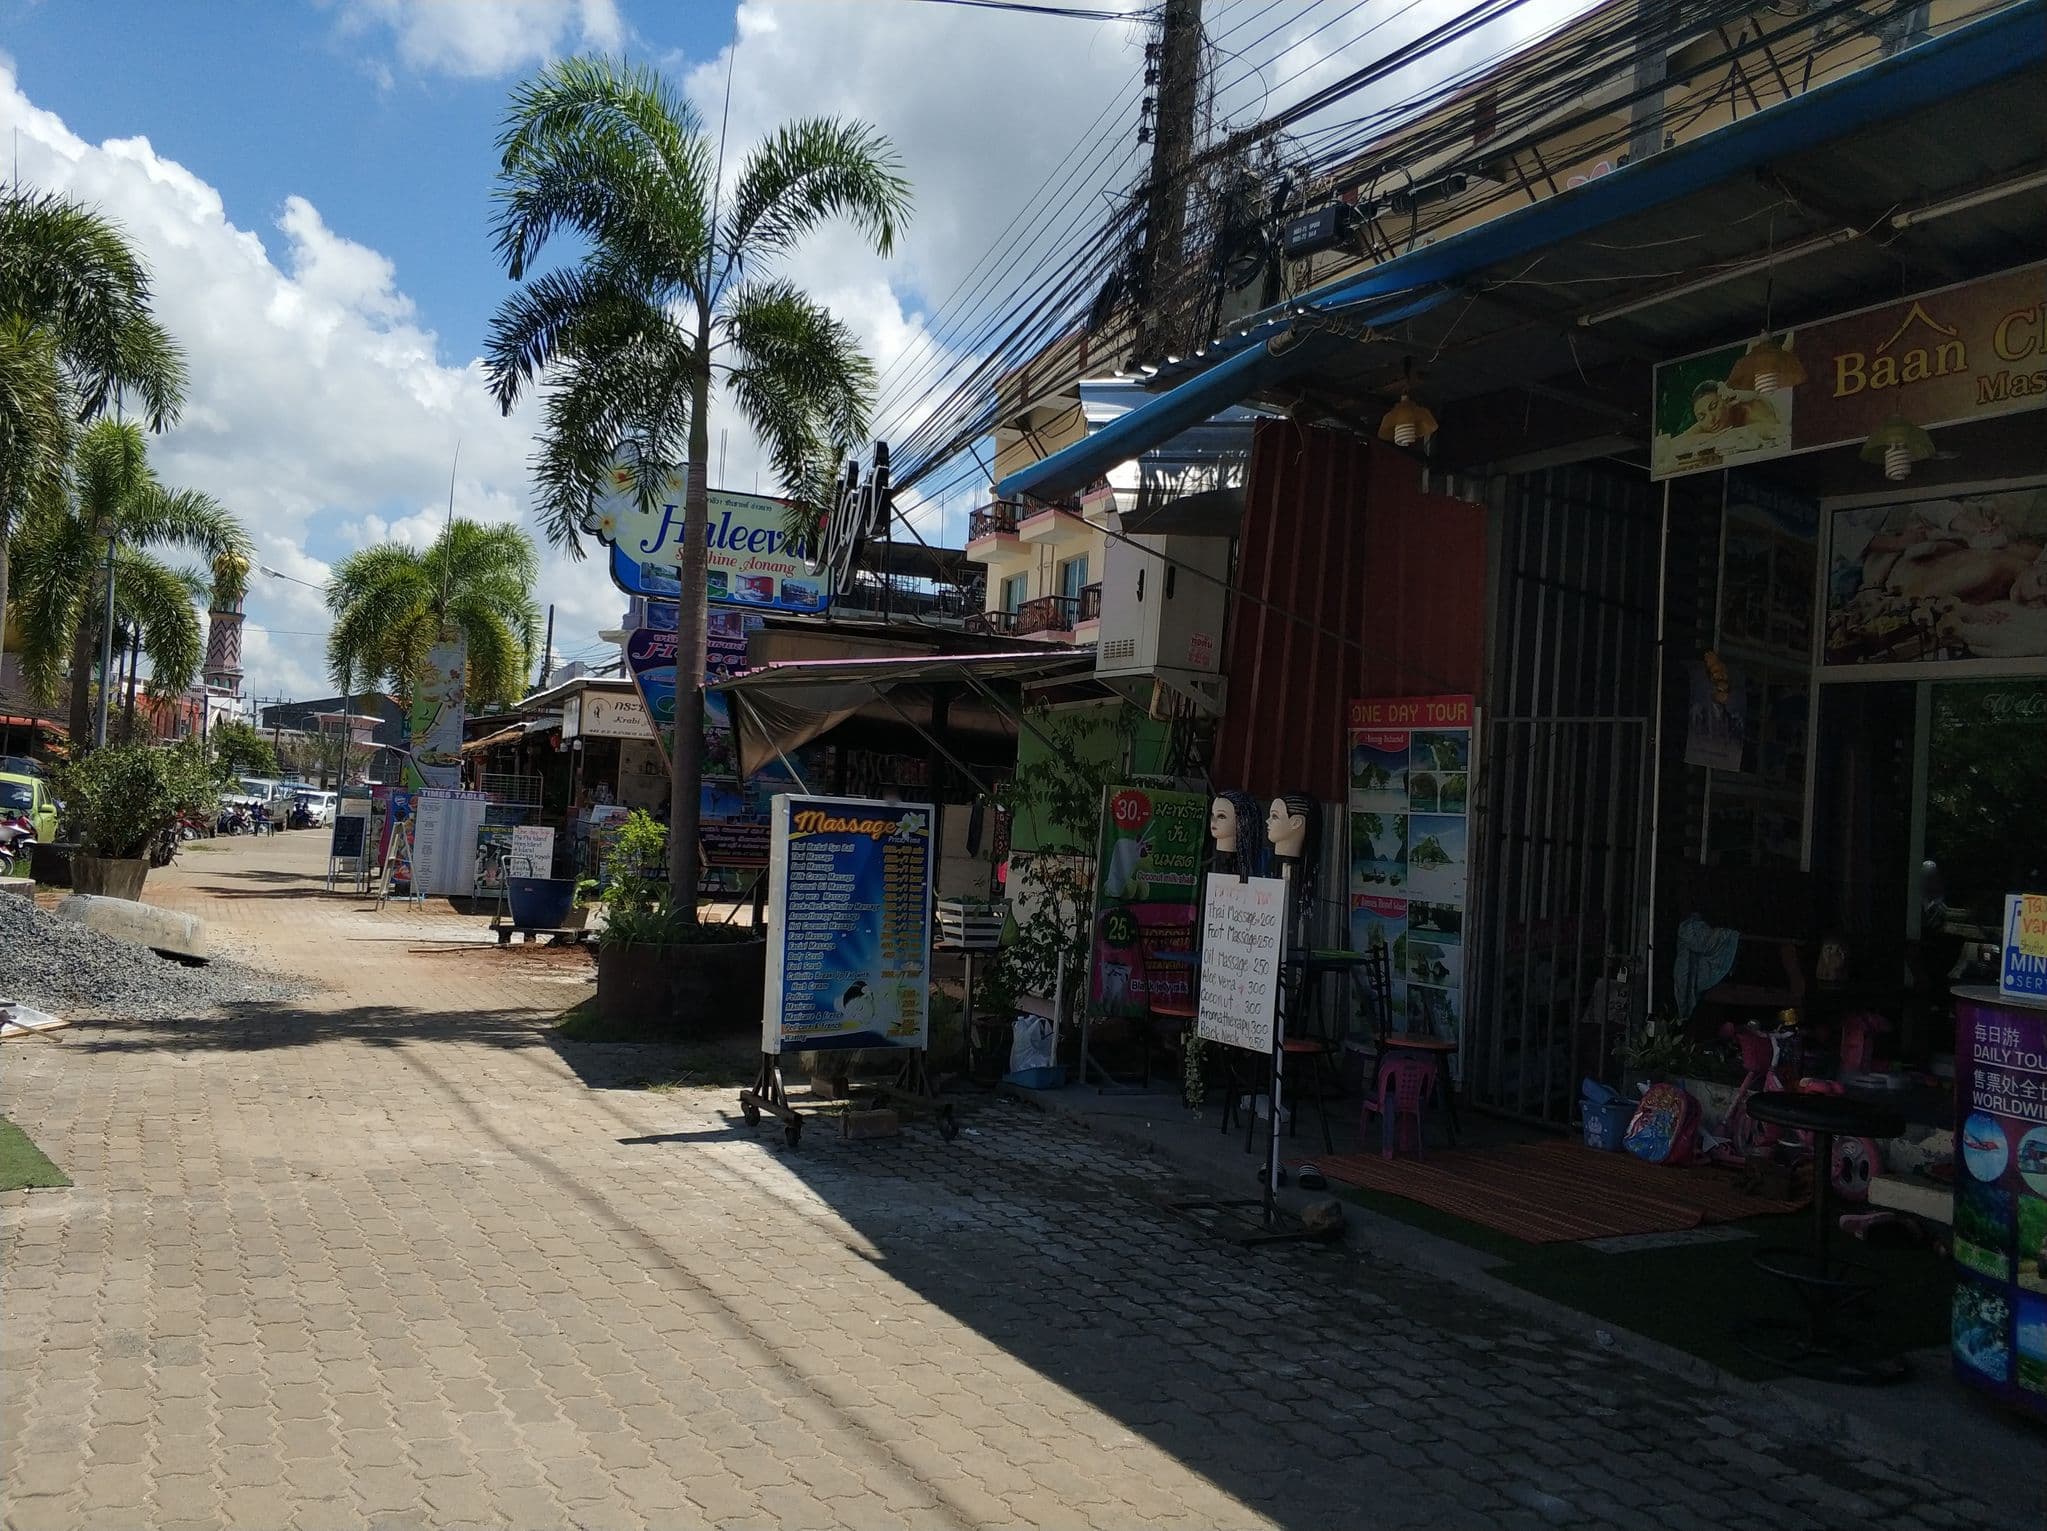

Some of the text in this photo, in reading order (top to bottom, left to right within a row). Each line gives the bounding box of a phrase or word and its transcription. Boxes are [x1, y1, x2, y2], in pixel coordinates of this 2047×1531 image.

[1351, 702, 1468, 722] ONE DAY TOUR
[455, 792, 486, 801] TABLE
[794, 810, 897, 840] Massage
[806, 852, 834, 862] Massage
[806, 862, 834, 872] Massage
[827, 872, 855, 882] Massage
[828, 882, 855, 892] Massage
[823, 892, 851, 902] Massage
[854, 902, 880, 911] Massage
[1208, 900, 1225, 919] Thai
[833, 912, 860, 921] Massage
[828, 922, 856, 931] Massage
[1208, 923, 1224, 939] Foot
[804, 932, 833, 941] Massage
[808, 942, 836, 951] Massage
[1218, 951, 1248, 977] Massage
[1253, 957, 1269, 975] 250
[1248, 981, 1266, 995] 300
[1200, 988, 1261, 1015] Coconut 300
[1251, 1020, 1268, 1035] 300
[1974, 1021, 2020, 1048] 每日游
[1974, 1043, 2012, 1063] DAILY
[1973, 1090, 2047, 1119] WORLDWI
